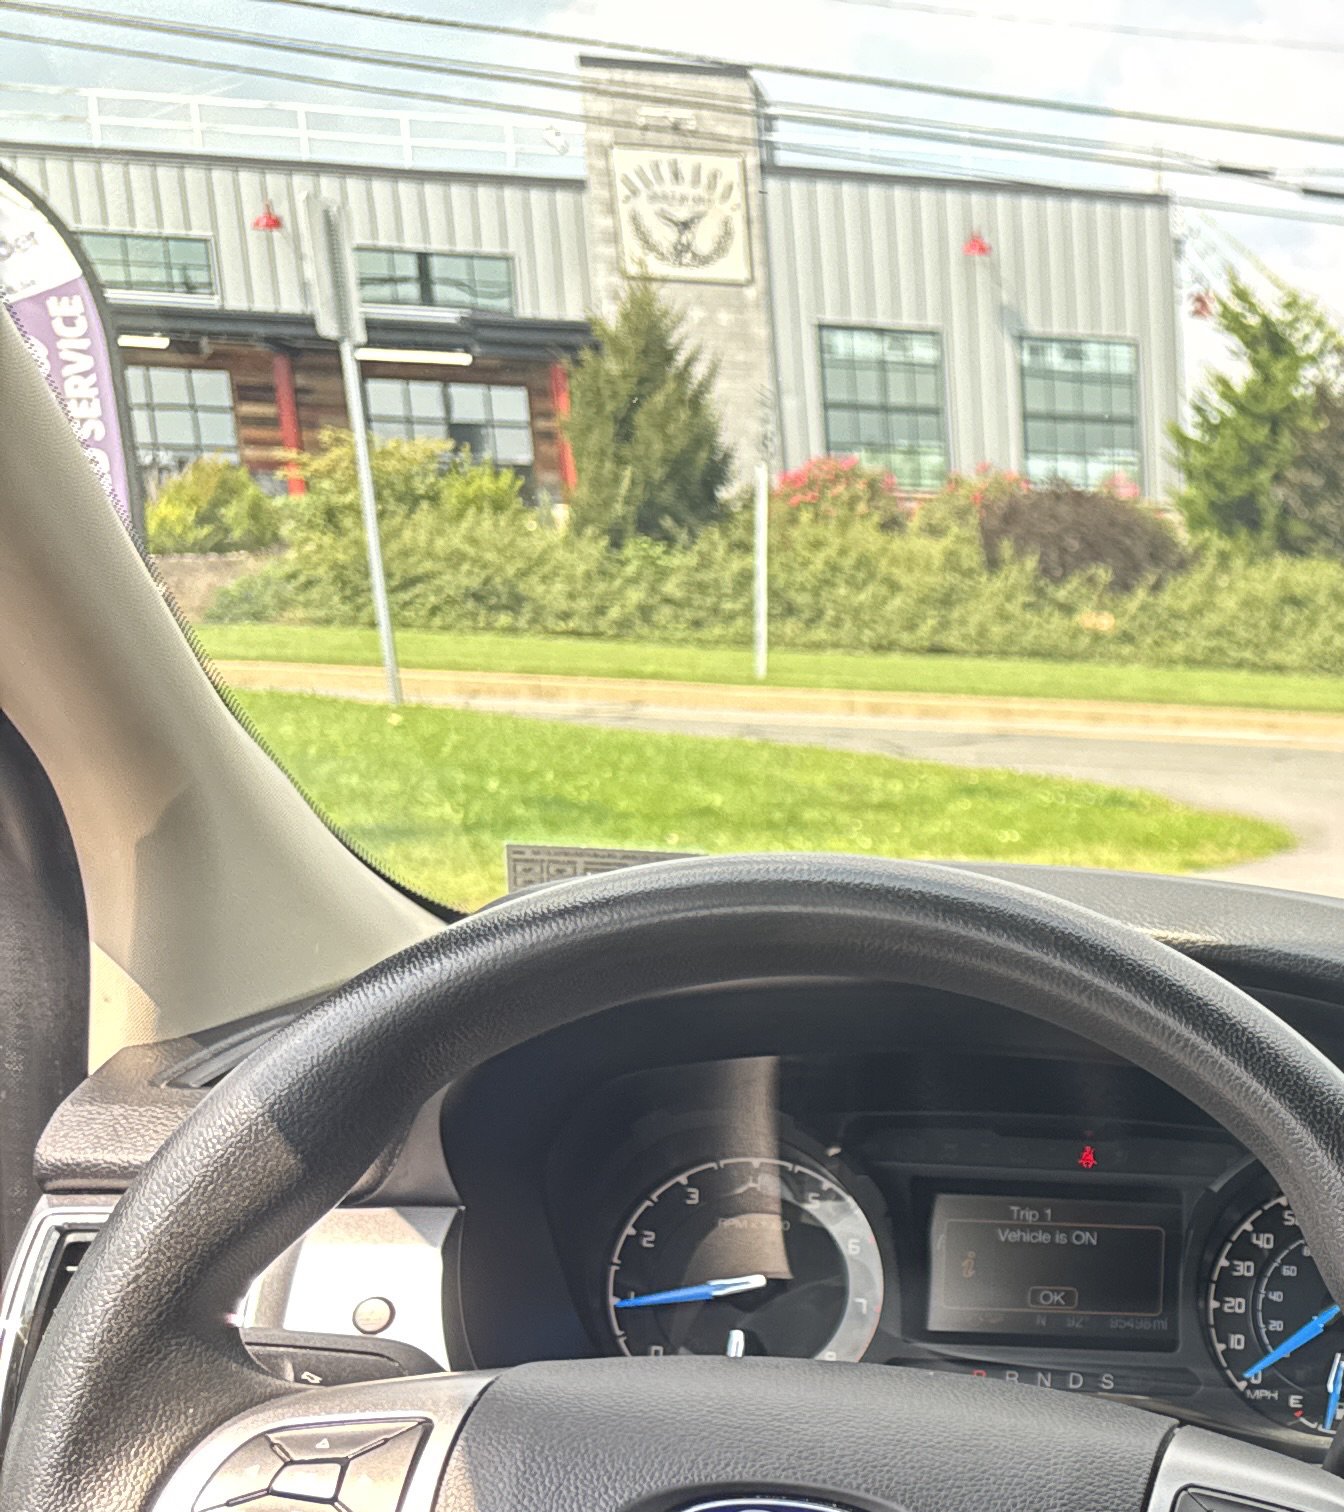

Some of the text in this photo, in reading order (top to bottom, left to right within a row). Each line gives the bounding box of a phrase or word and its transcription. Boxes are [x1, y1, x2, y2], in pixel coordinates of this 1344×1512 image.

[46, 295, 106, 442] SERVICE
[686, 1188, 699, 1204] 3
[1009, 1206, 1052, 1222] Trip 1
[642, 1231, 656, 1247] 2
[998, 1228, 1098, 1246] Vehicle is ON
[1252, 1233, 1273, 1248] 40
[848, 1239, 860, 1254] 6
[1231, 1261, 1254, 1276] 30
[1282, 1266, 1297, 1276] 60
[1039, 1290, 1065, 1305] OK
[1268, 1292, 1283, 1302] 40
[855, 1298, 867, 1314] 7
[1222, 1298, 1245, 1313] 20
[1268, 1320, 1283, 1331] 20
[1230, 1334, 1245, 1350] 10
[1037, 1371, 1051, 1387] N
[1069, 1373, 1083, 1389] D
[1102, 1373, 1114, 1389] S
[1246, 1390, 1278, 1400] MPH
[1289, 1395, 1303, 1407] E
